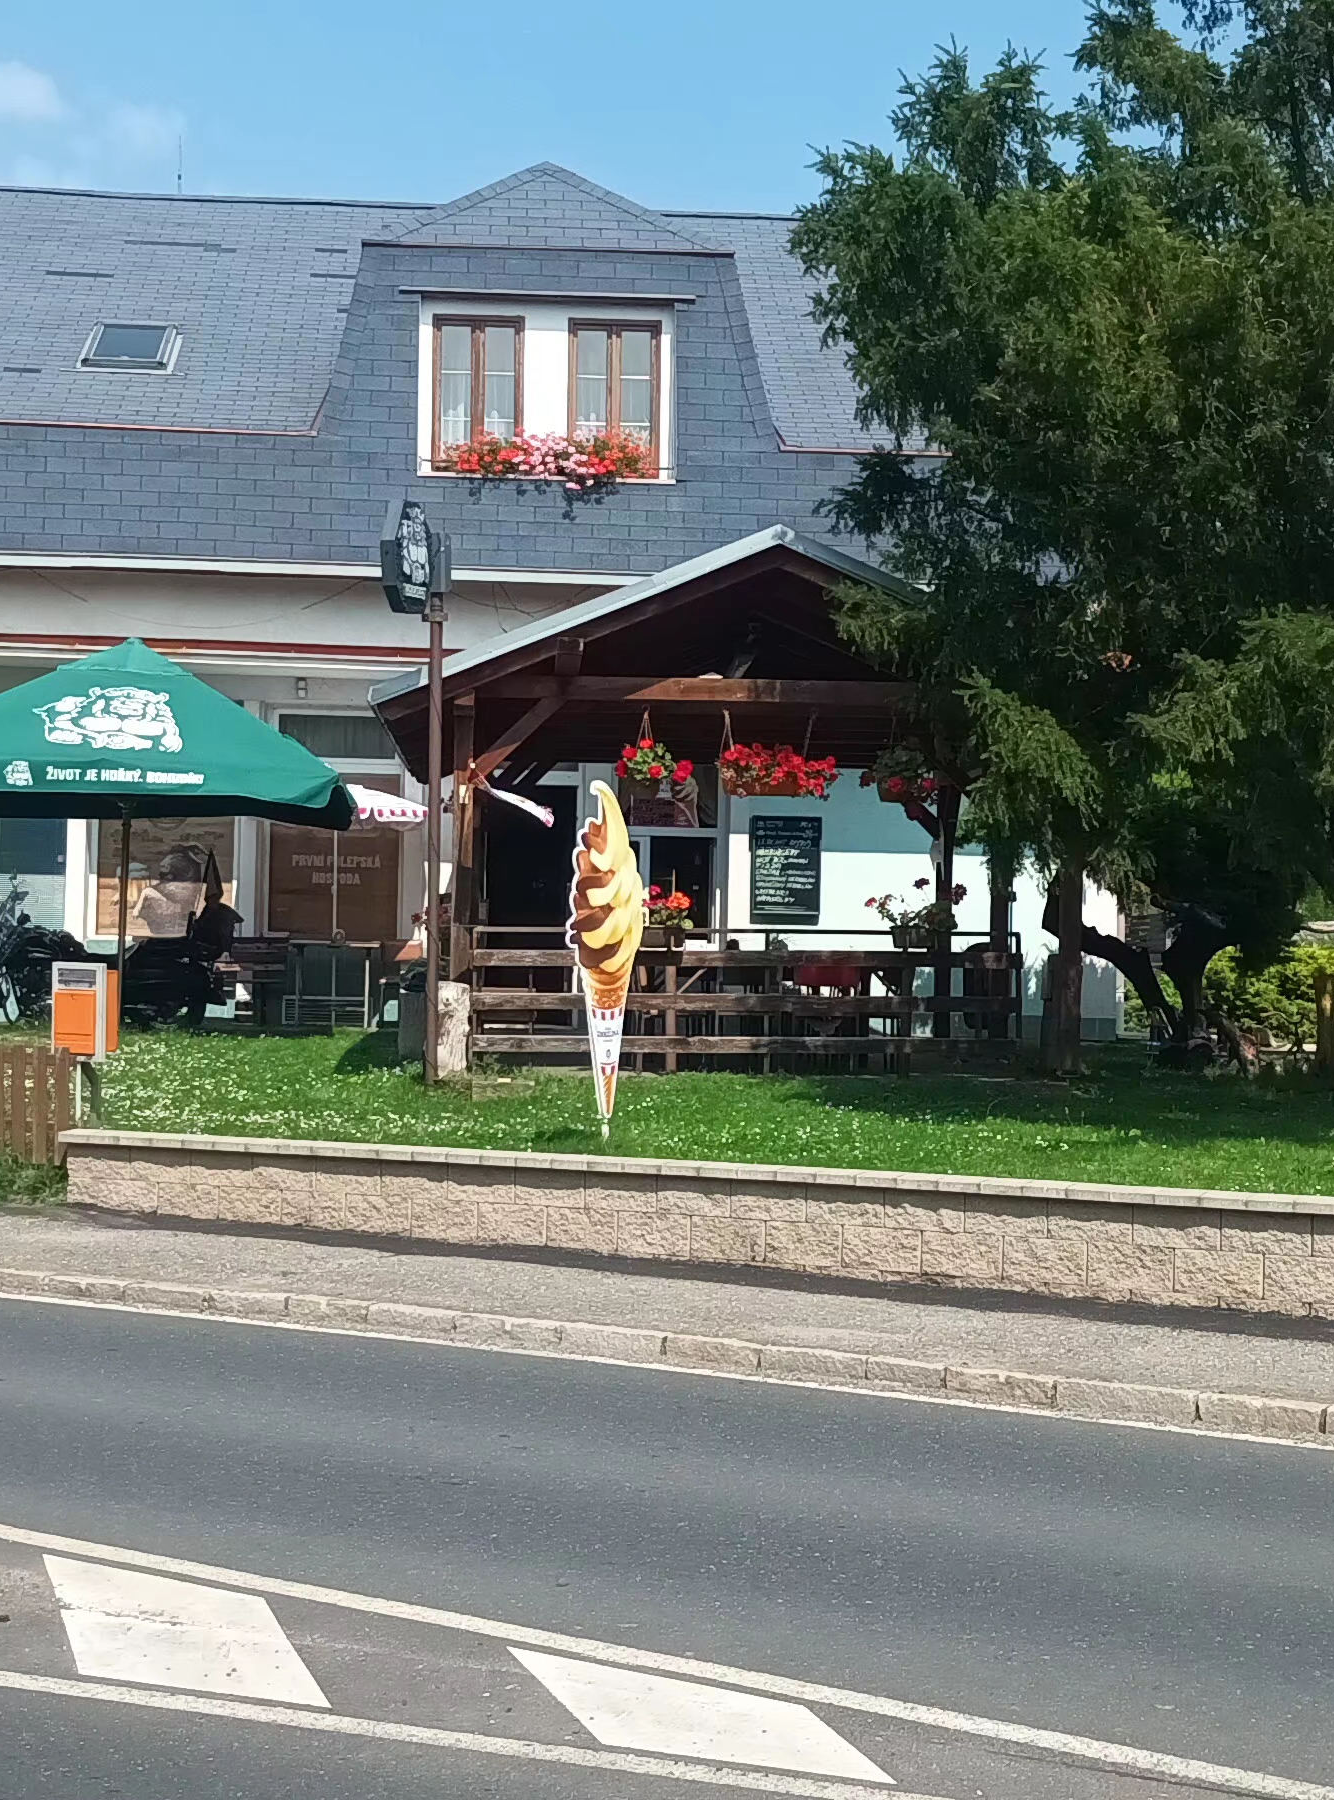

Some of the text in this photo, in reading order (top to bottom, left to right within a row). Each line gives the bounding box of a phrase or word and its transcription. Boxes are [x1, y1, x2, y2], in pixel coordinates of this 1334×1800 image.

[46, 765, 82, 781] ŽIVOT
[84, 769, 99, 781] JE
[291, 853, 381, 868] PRVNÍ PLEPSKÁ
[312, 871, 361, 885] HOSODA
